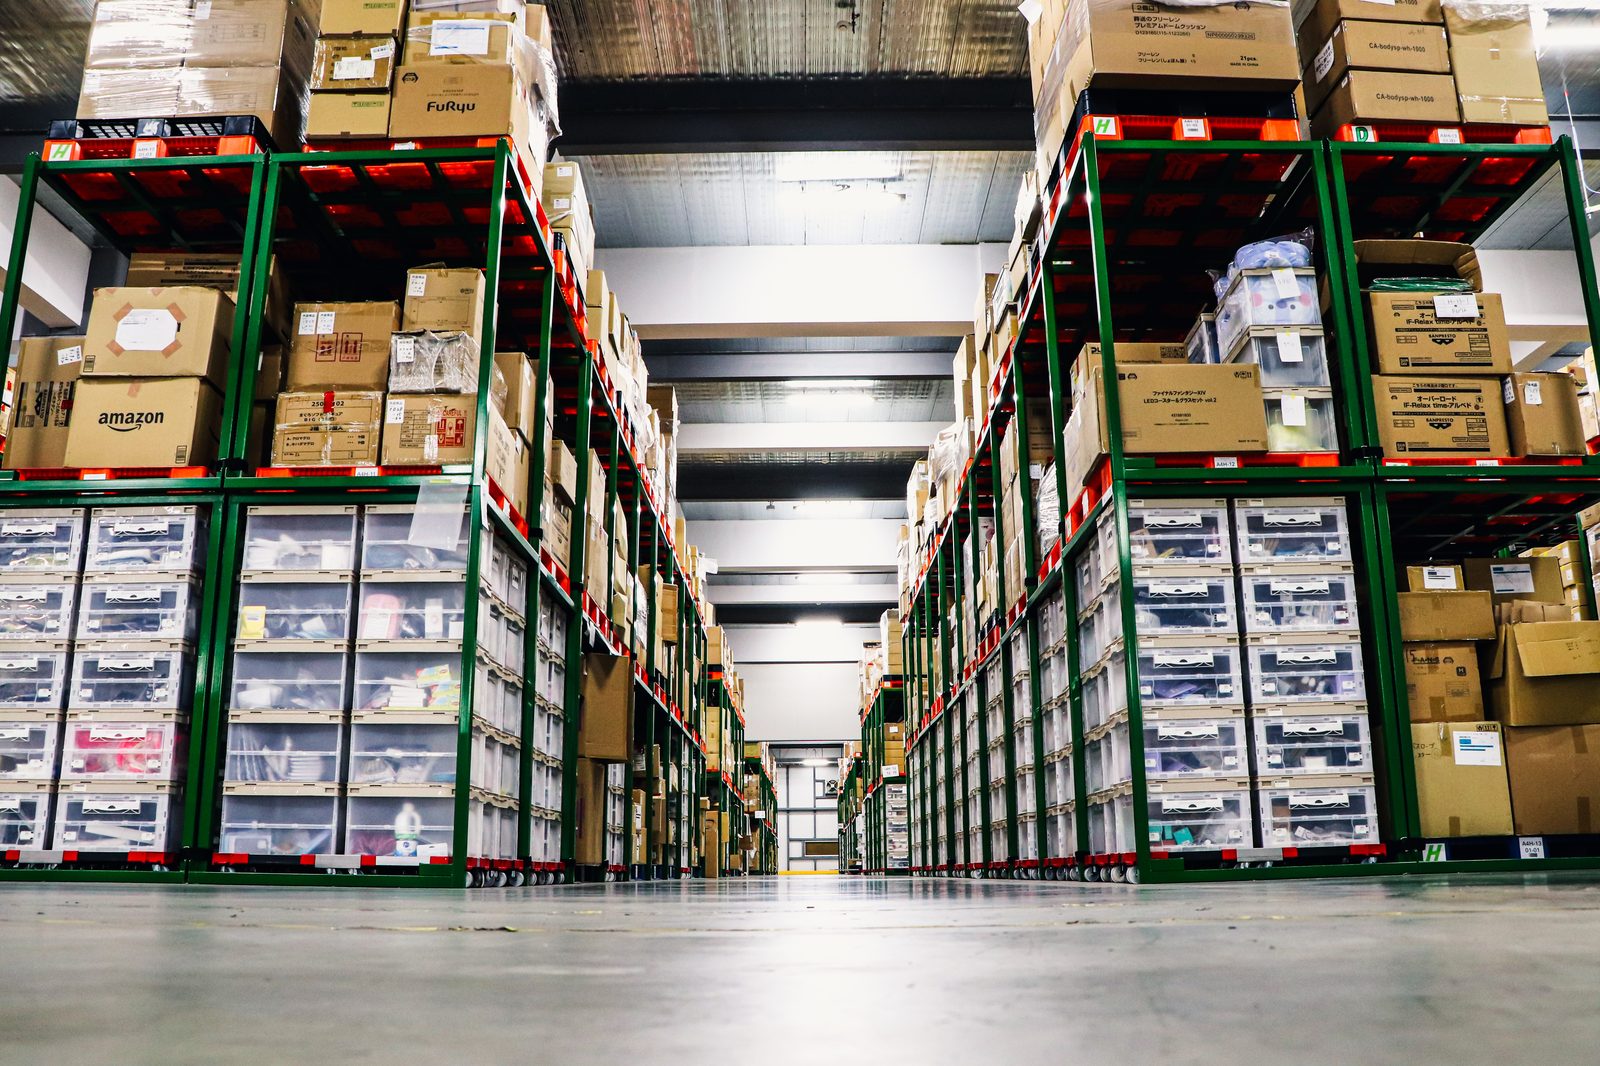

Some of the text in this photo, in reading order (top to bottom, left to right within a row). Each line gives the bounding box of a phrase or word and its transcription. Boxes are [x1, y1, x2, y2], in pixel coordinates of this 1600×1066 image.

[1368, 42, 1426, 53] CA-bodysp-wh-1000
[1375, 92, 1435, 103] CA-bodysp-wh-1000
[427, 100, 476, 114] FuRyu
[1095, 118, 1110, 134] H
[1355, 126, 1369, 143] D
[52, 144, 71, 159] H
[98, 412, 164, 425] amazon
[1425, 844, 1443, 862] H
